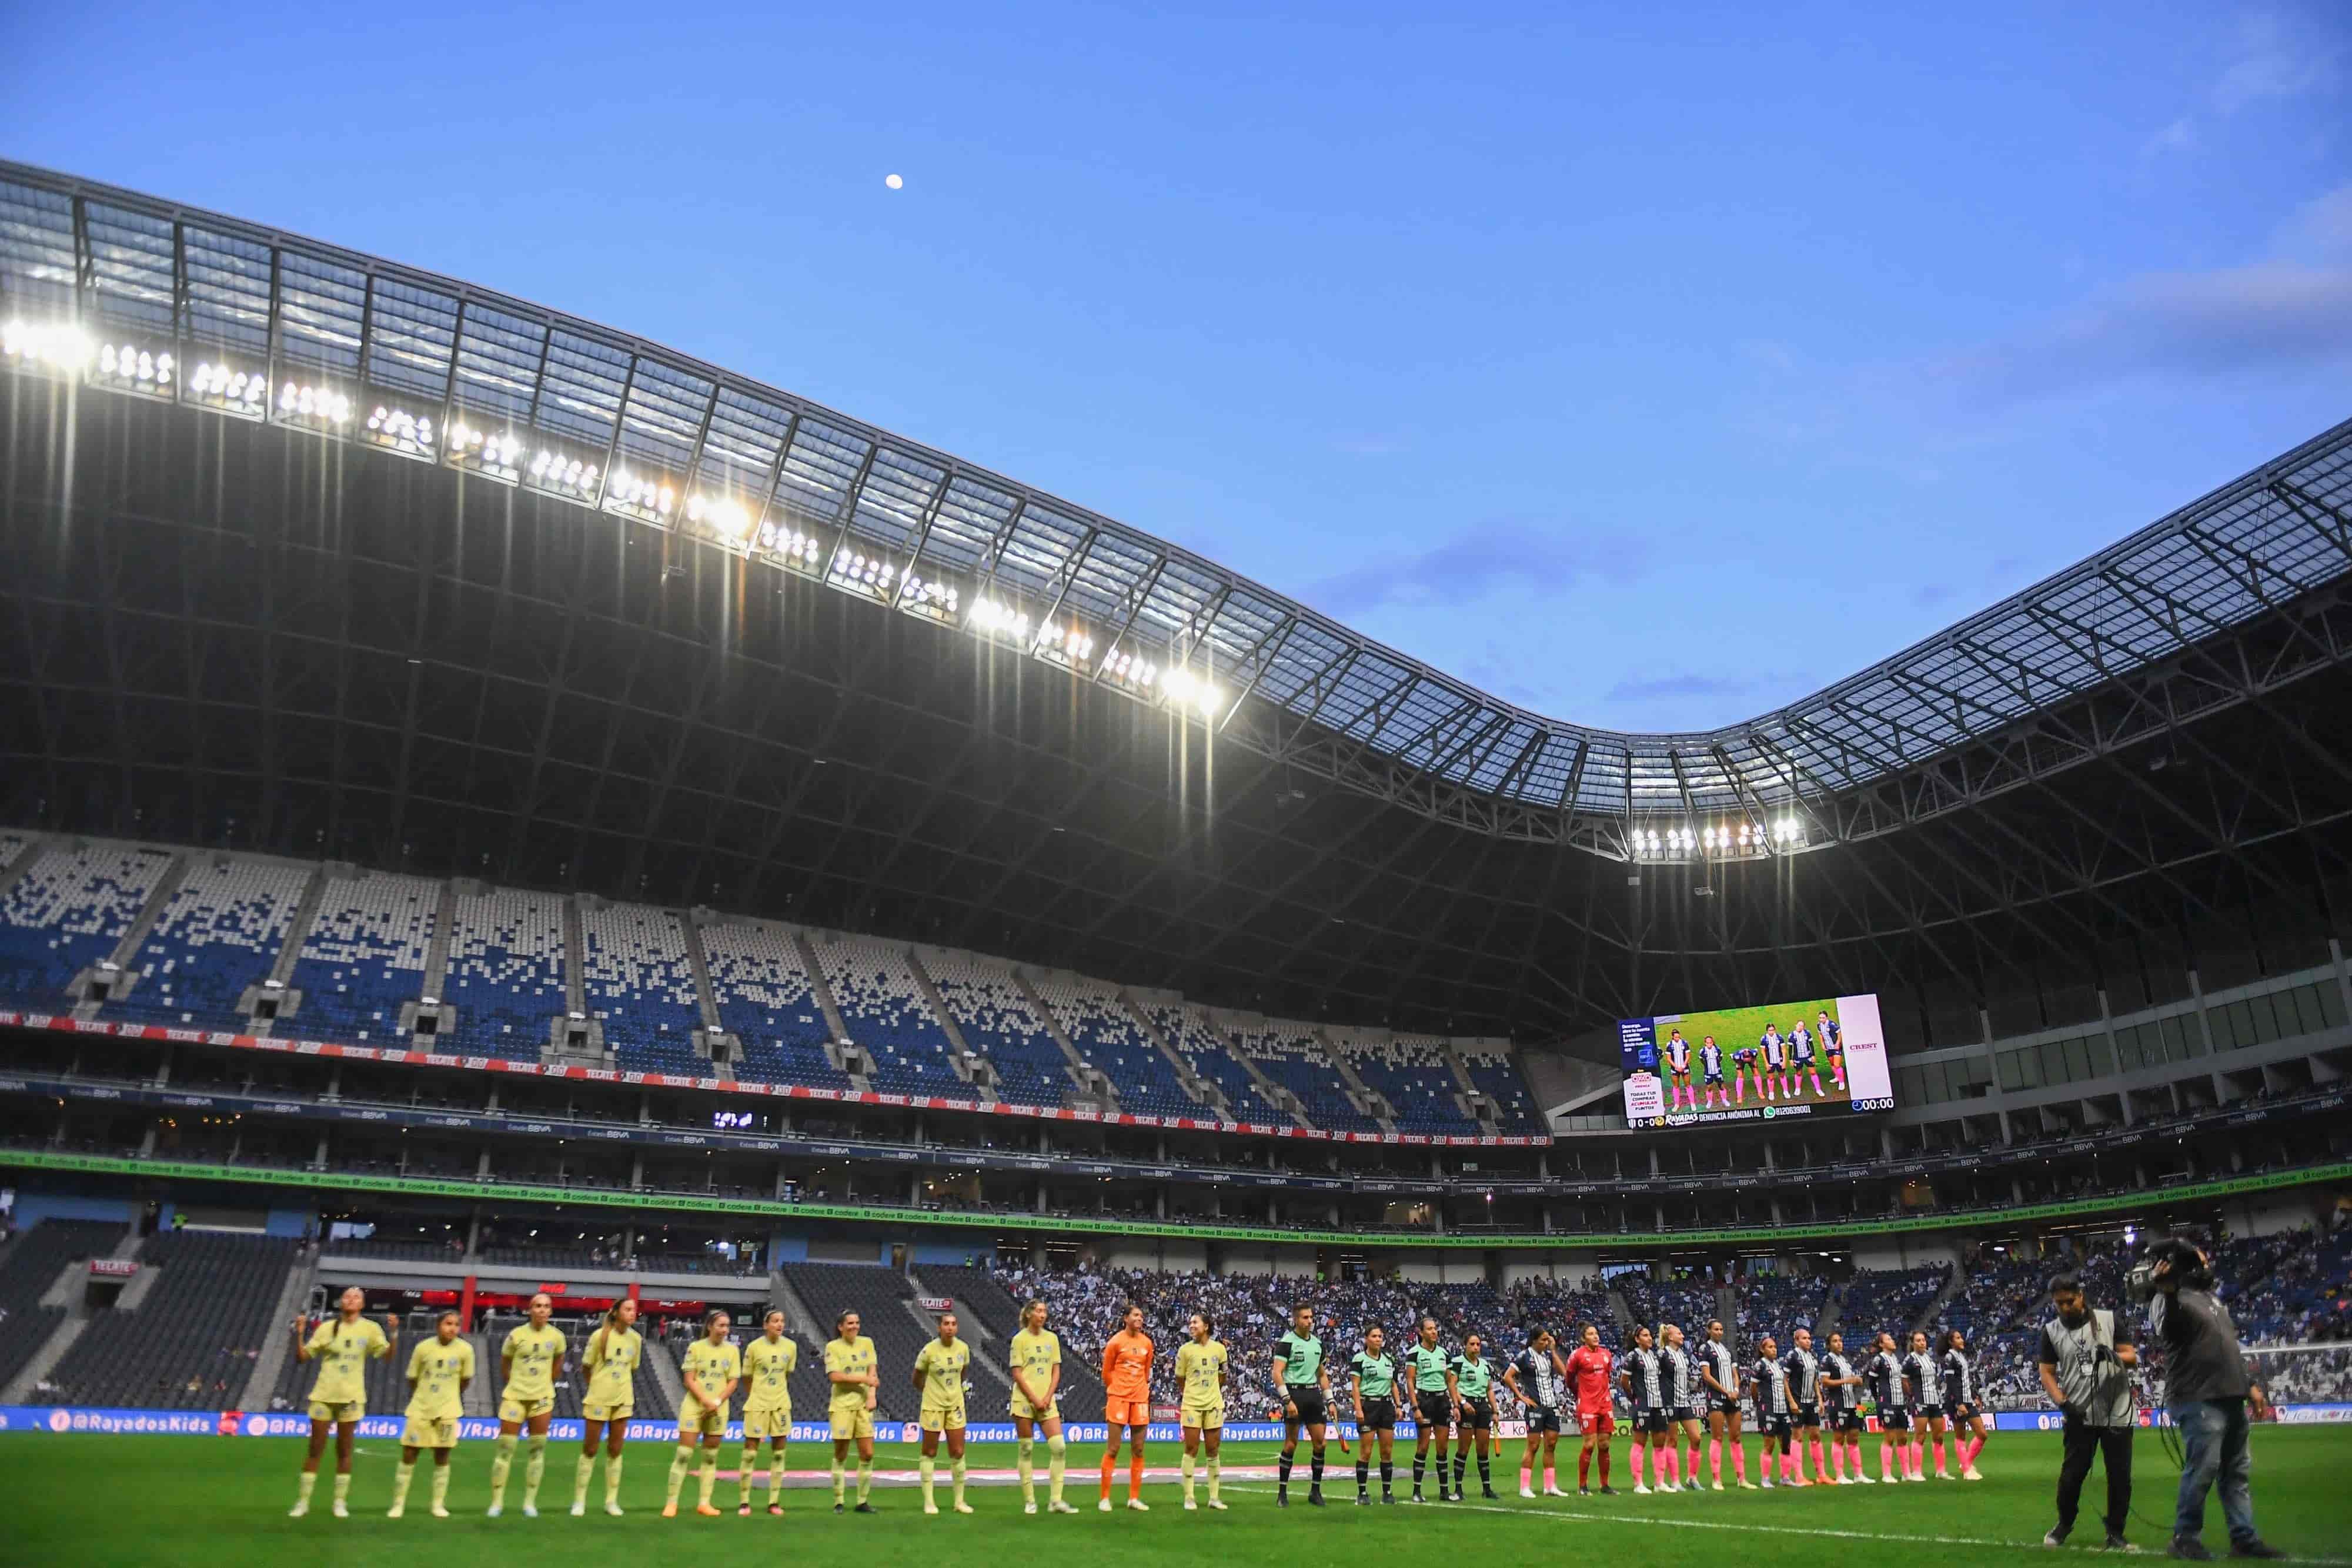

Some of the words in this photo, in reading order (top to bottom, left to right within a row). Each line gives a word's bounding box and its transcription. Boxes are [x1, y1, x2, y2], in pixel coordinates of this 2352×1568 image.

[425, 1054, 456, 1066] TECATE
[507, 1062, 537, 1074] TECATE
[586, 1069, 614, 1080] TECATE
[662, 1075, 690, 1087] TECATE
[737, 1082, 765, 1094] TECATE
[808, 1088, 835, 1099] TECATE
[878, 1094, 904, 1105] TECATE
[946, 1099, 969, 1110] TECATE
[1863, 1098, 1894, 1110] 00:00
[2320, 1096, 2344, 1108] BBVA
[1010, 1105, 1033, 1115] TECATE
[1073, 1110, 1097, 1121] TECATE
[1134, 1115, 1157, 1125] TECATE
[1665, 1114, 1699, 1125] RAYADAS
[1699, 1112, 1726, 1122] DENUNCIA
[2244, 1110, 2267, 1122] BBVA
[446, 1118, 471, 1127] BBVA
[1193, 1119, 1215, 1130] TECATE
[527, 1124, 552, 1133] BBVA
[1250, 1124, 1271, 1135] TECATE
[1306, 1128, 1327, 1138] TECATE
[2175, 1123, 2195, 1134] BBVA
[606, 1131, 630, 1139] BBVA
[1354, 1134, 1377, 1142] TECATE
[1403, 1135, 1425, 1144] TECATE
[2122, 1134, 2141, 1145] BBVA
[683, 1136, 706, 1145] BBVA
[1502, 1136, 1524, 1145] TECATE
[757, 1142, 779, 1150] BBVA
[828, 1147, 850, 1155] BBVA
[2073, 1141, 2094, 1151] BBVA
[898, 1152, 918, 1160] BBVA
[2017, 1149, 2037, 1159] BBVA
[965, 1156, 985, 1165] BBVA
[1031, 1161, 1050, 1169] BBVA
[1960, 1156, 1980, 1166] BBVA
[1094, 1166, 1112, 1174] BBVA
[1849, 1169, 1869, 1178] BBVA
[1904, 1164, 1924, 1173] BBVA
[1793, 1174, 1812, 1182] BBVA
[650, 1198, 677, 1206] codere
[686, 1200, 712, 1208] codere
[726, 1202, 753, 1211] codere
[761, 1204, 787, 1212] codere
[800, 1206, 824, 1215] codere
[834, 1209, 858, 1217] codere
[871, 1211, 896, 1219] codere
[72, 1415, 209, 1432] @RayadosKids
